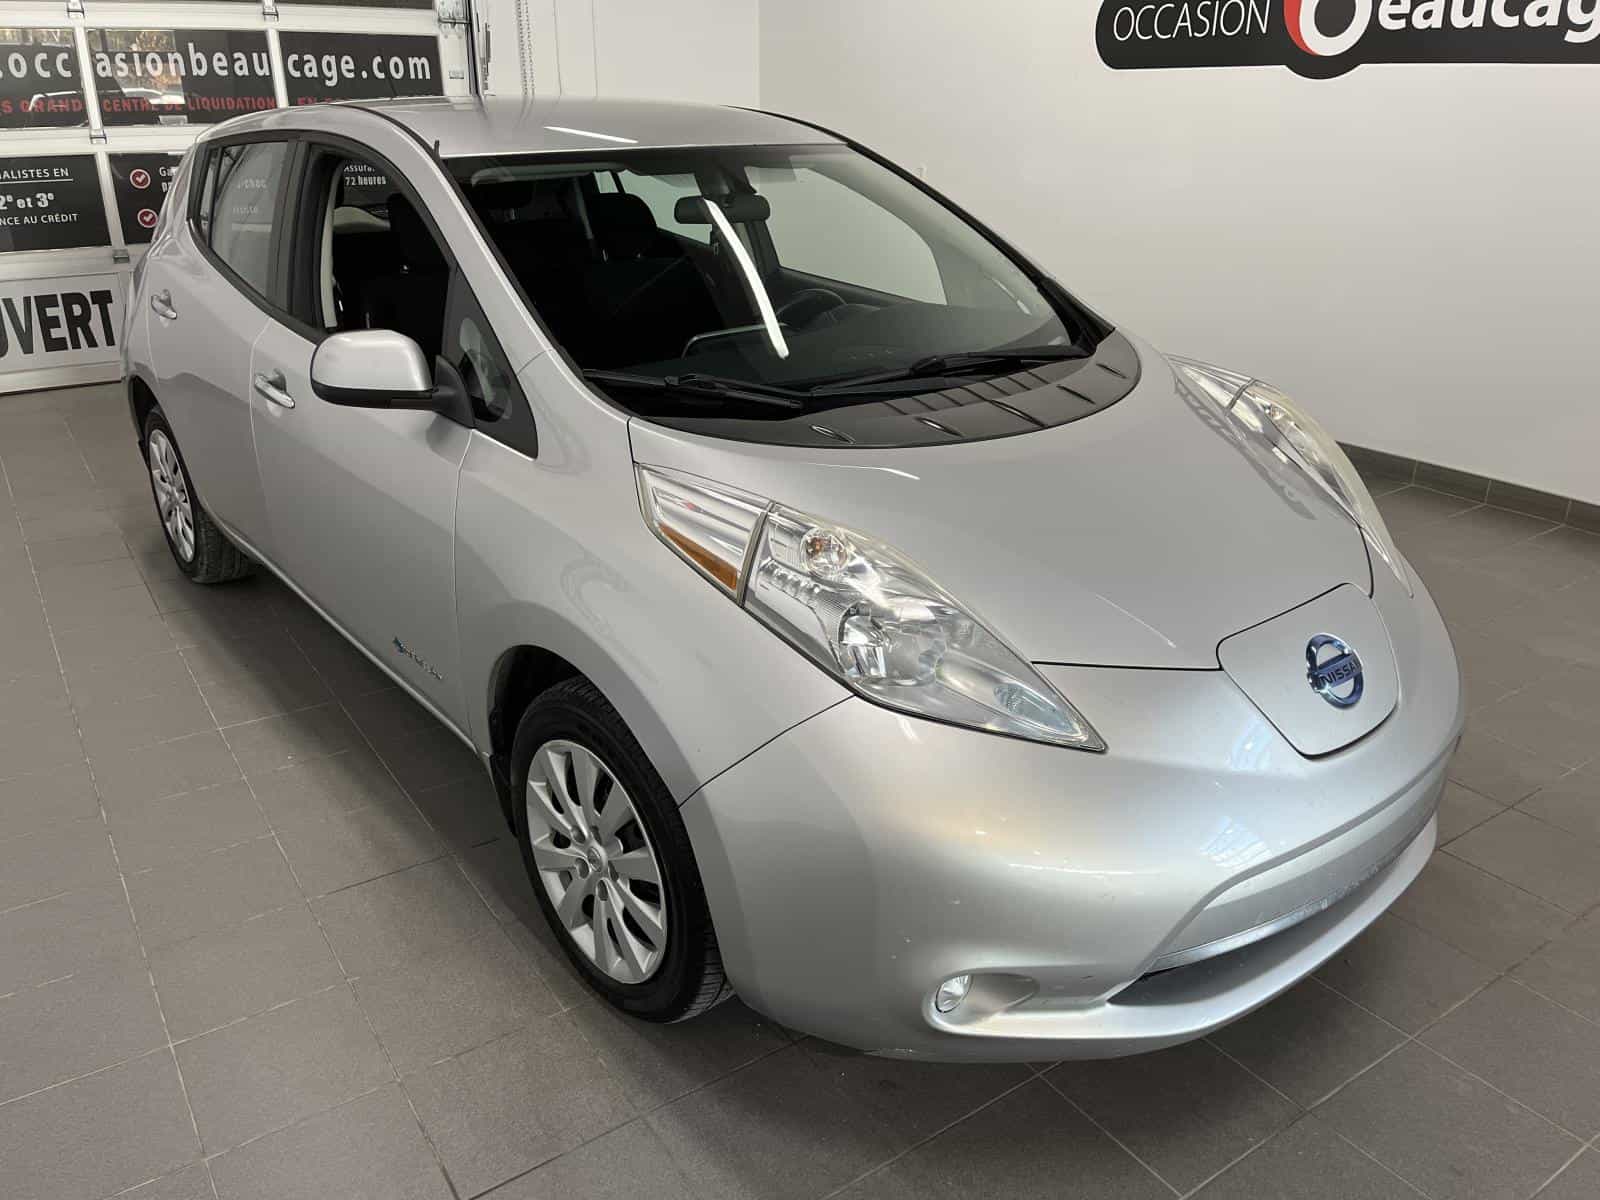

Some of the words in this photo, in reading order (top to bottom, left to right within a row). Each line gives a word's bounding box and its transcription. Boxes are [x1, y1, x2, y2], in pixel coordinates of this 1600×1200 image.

[1113, 0, 1270, 41] OCCASION
[187, 96, 276, 111] LIQUIDATION
[53, 167, 69, 177] EN
[344, 176, 357, 187] 72
[23, 215, 38, 225] AU
